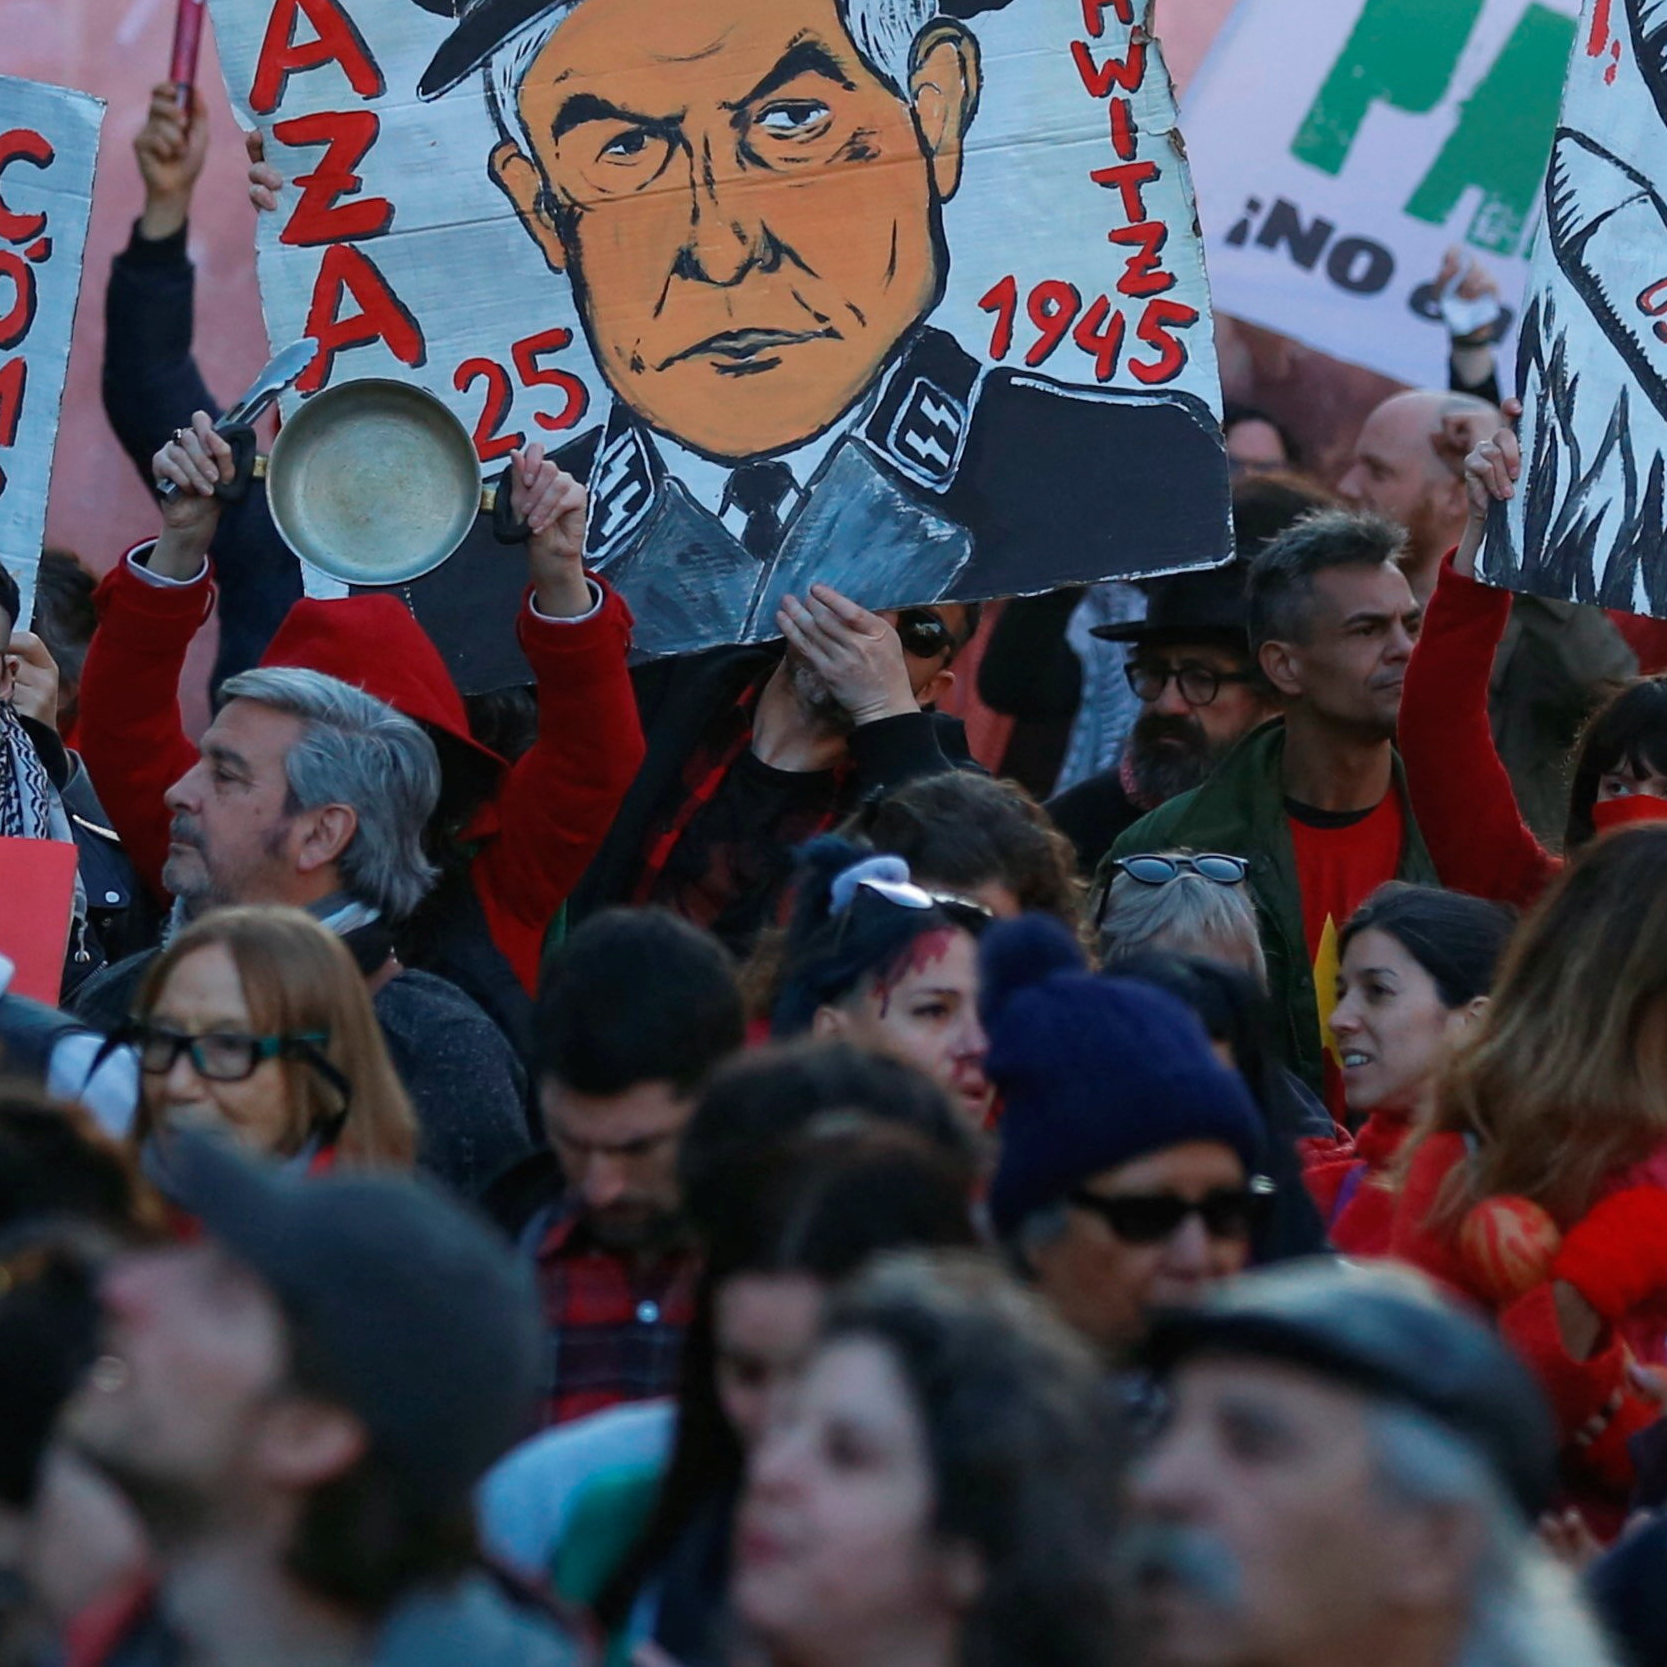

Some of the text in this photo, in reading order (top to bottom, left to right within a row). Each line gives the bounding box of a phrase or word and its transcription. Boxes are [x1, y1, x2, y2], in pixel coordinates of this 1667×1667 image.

[1224, 194, 1396, 298] ¡NO
[977, 274, 1200, 386] 1945
[453, 328, 590, 463] 25
